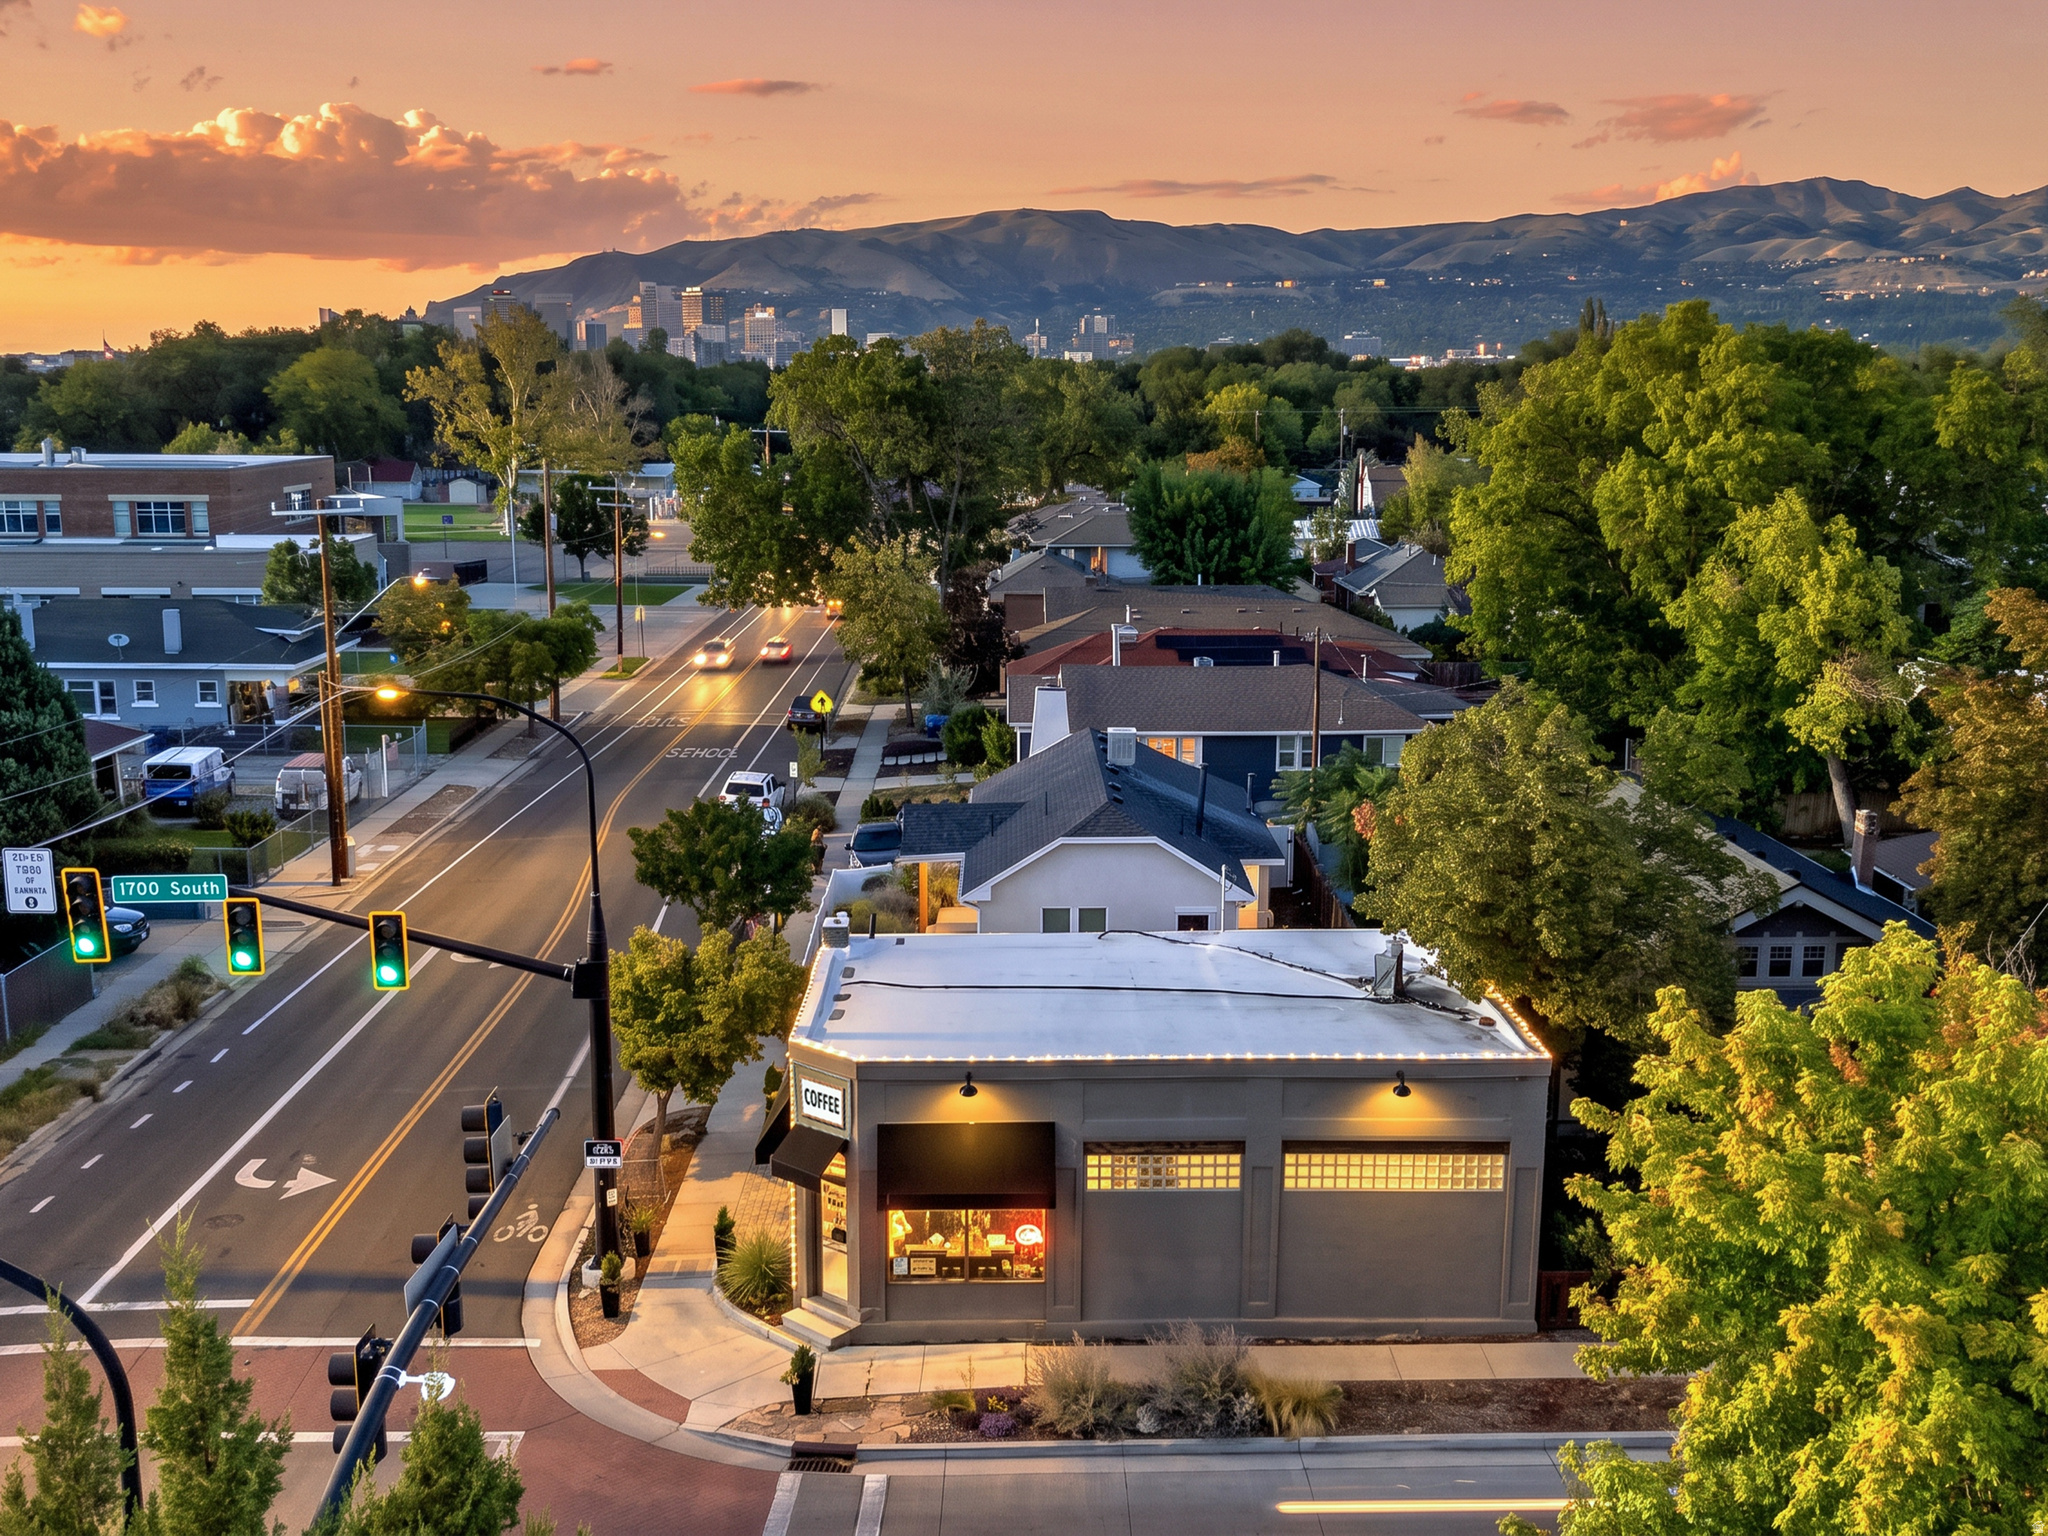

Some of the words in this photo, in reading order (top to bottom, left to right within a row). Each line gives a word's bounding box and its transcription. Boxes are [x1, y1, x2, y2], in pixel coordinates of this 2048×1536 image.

[119, 881, 159, 896] 1700
[170, 881, 220, 896] South
[804, 1087, 840, 1115] COFFEE
